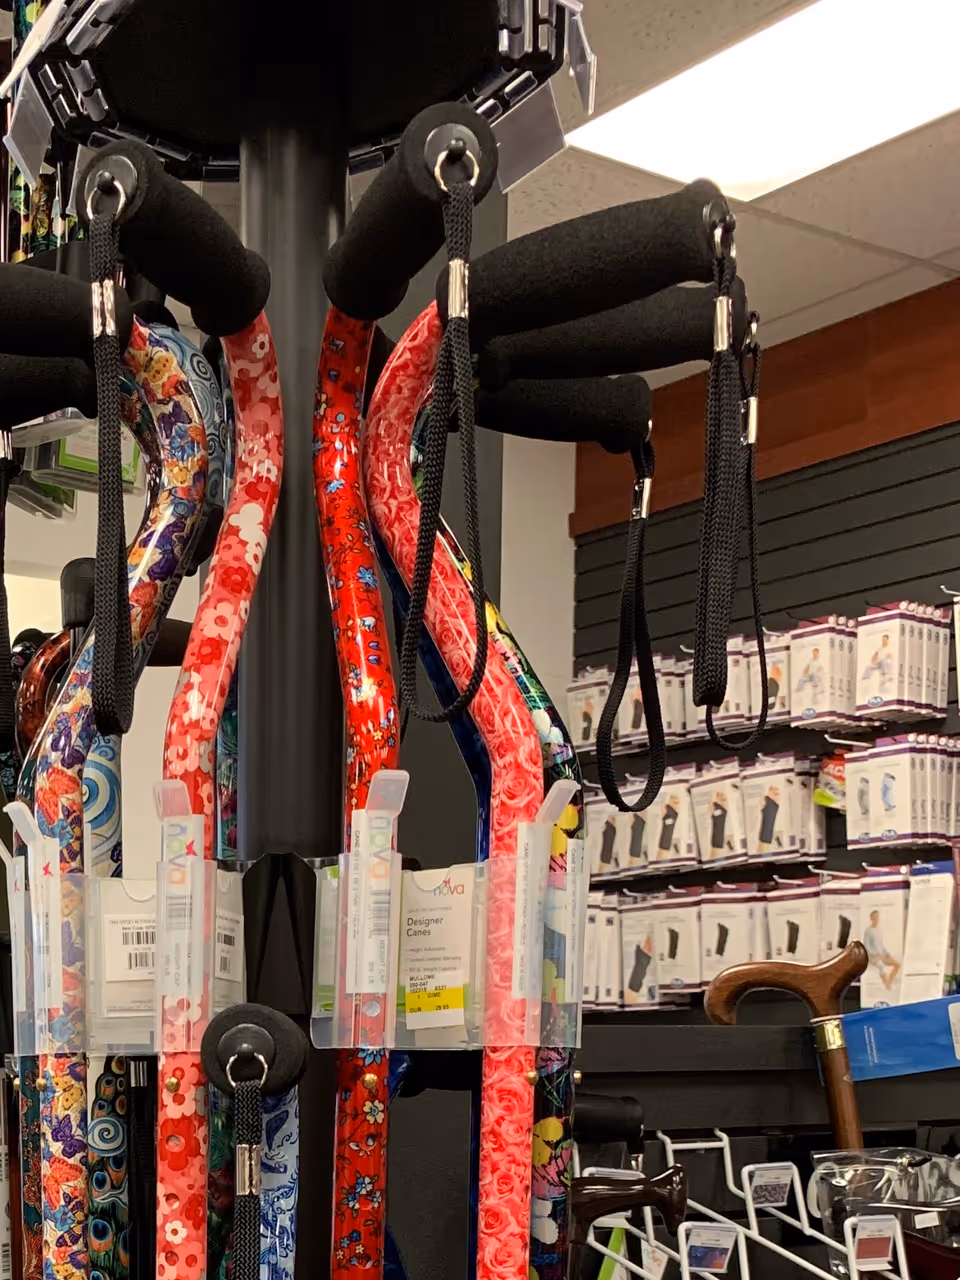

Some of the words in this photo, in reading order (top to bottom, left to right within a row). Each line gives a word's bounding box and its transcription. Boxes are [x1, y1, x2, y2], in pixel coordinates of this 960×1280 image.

[368, 816, 391, 878] nova
[433, 883, 464, 897] nova
[407, 917, 444, 928] Designer
[406, 928, 431, 938] Canes
